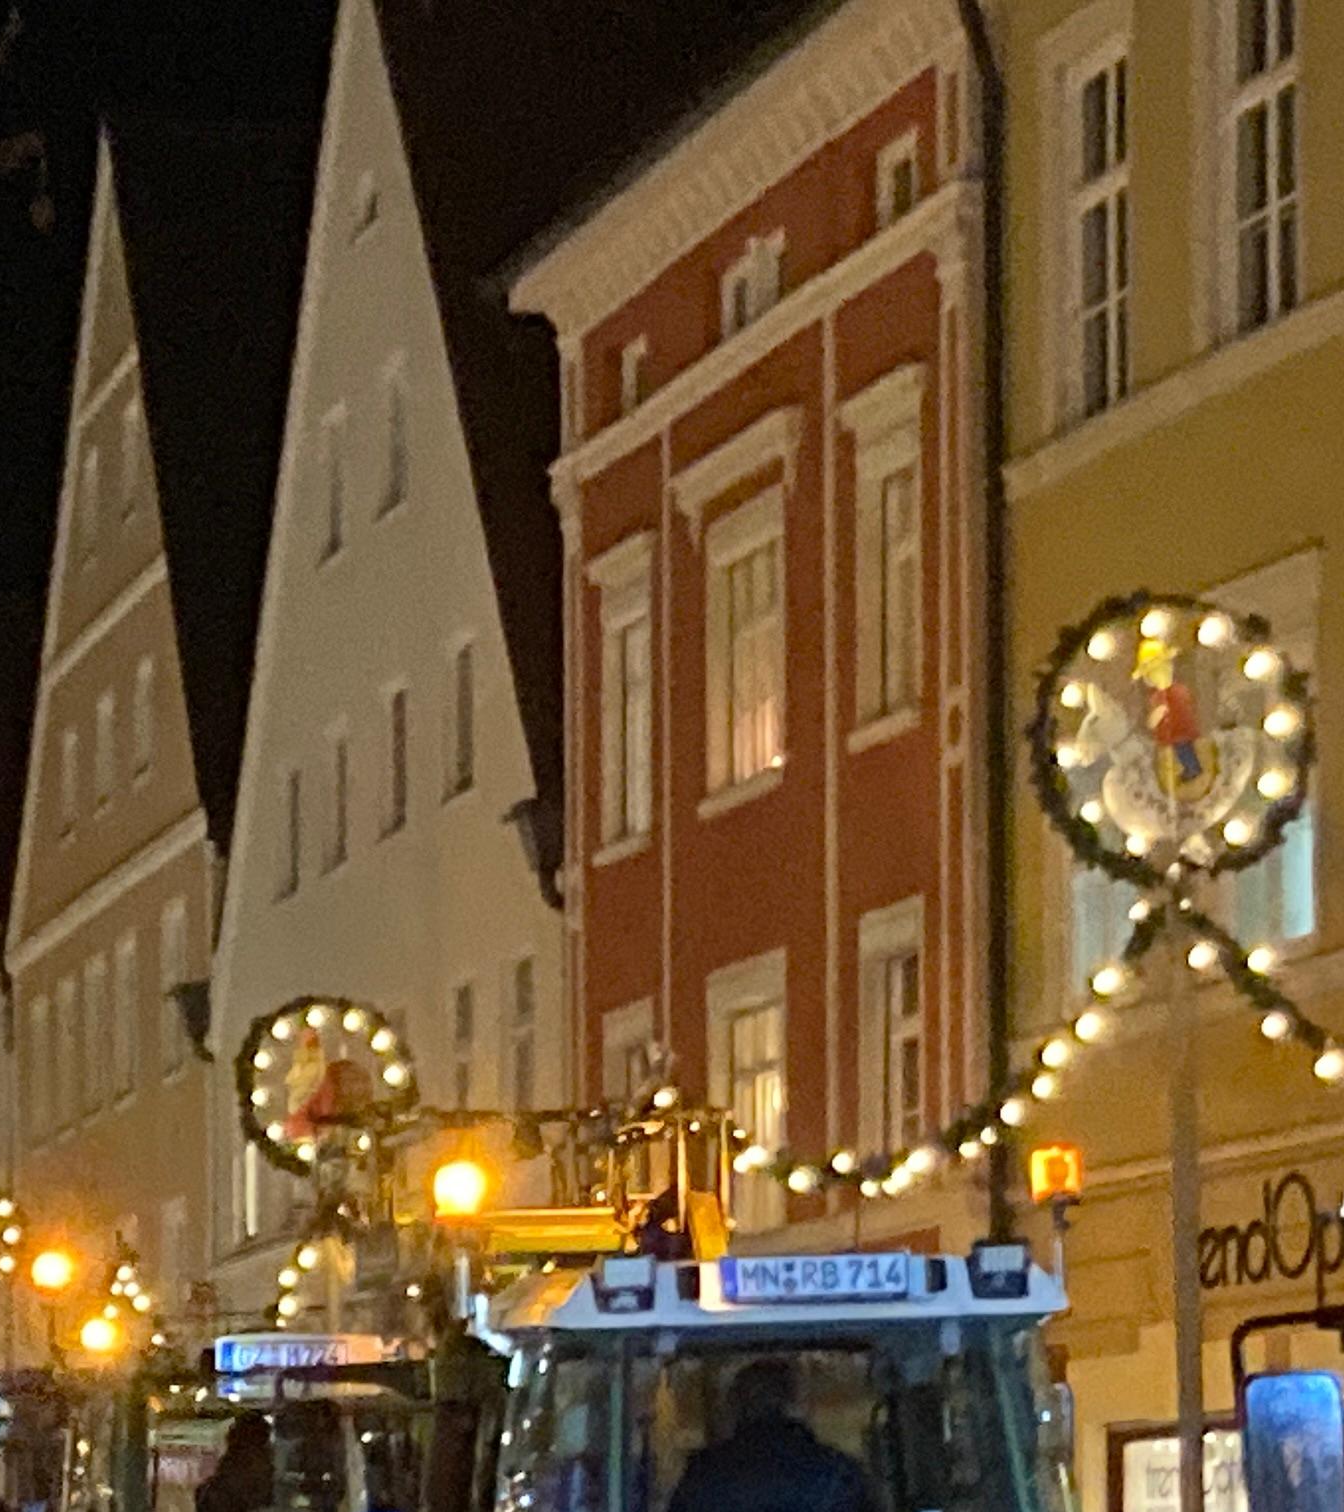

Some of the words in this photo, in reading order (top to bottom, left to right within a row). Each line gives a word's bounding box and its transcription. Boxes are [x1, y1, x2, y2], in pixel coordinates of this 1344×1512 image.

[741, 1261, 780, 1291] MN
[802, 1260, 838, 1289] RB
[846, 1258, 902, 1288] 714
